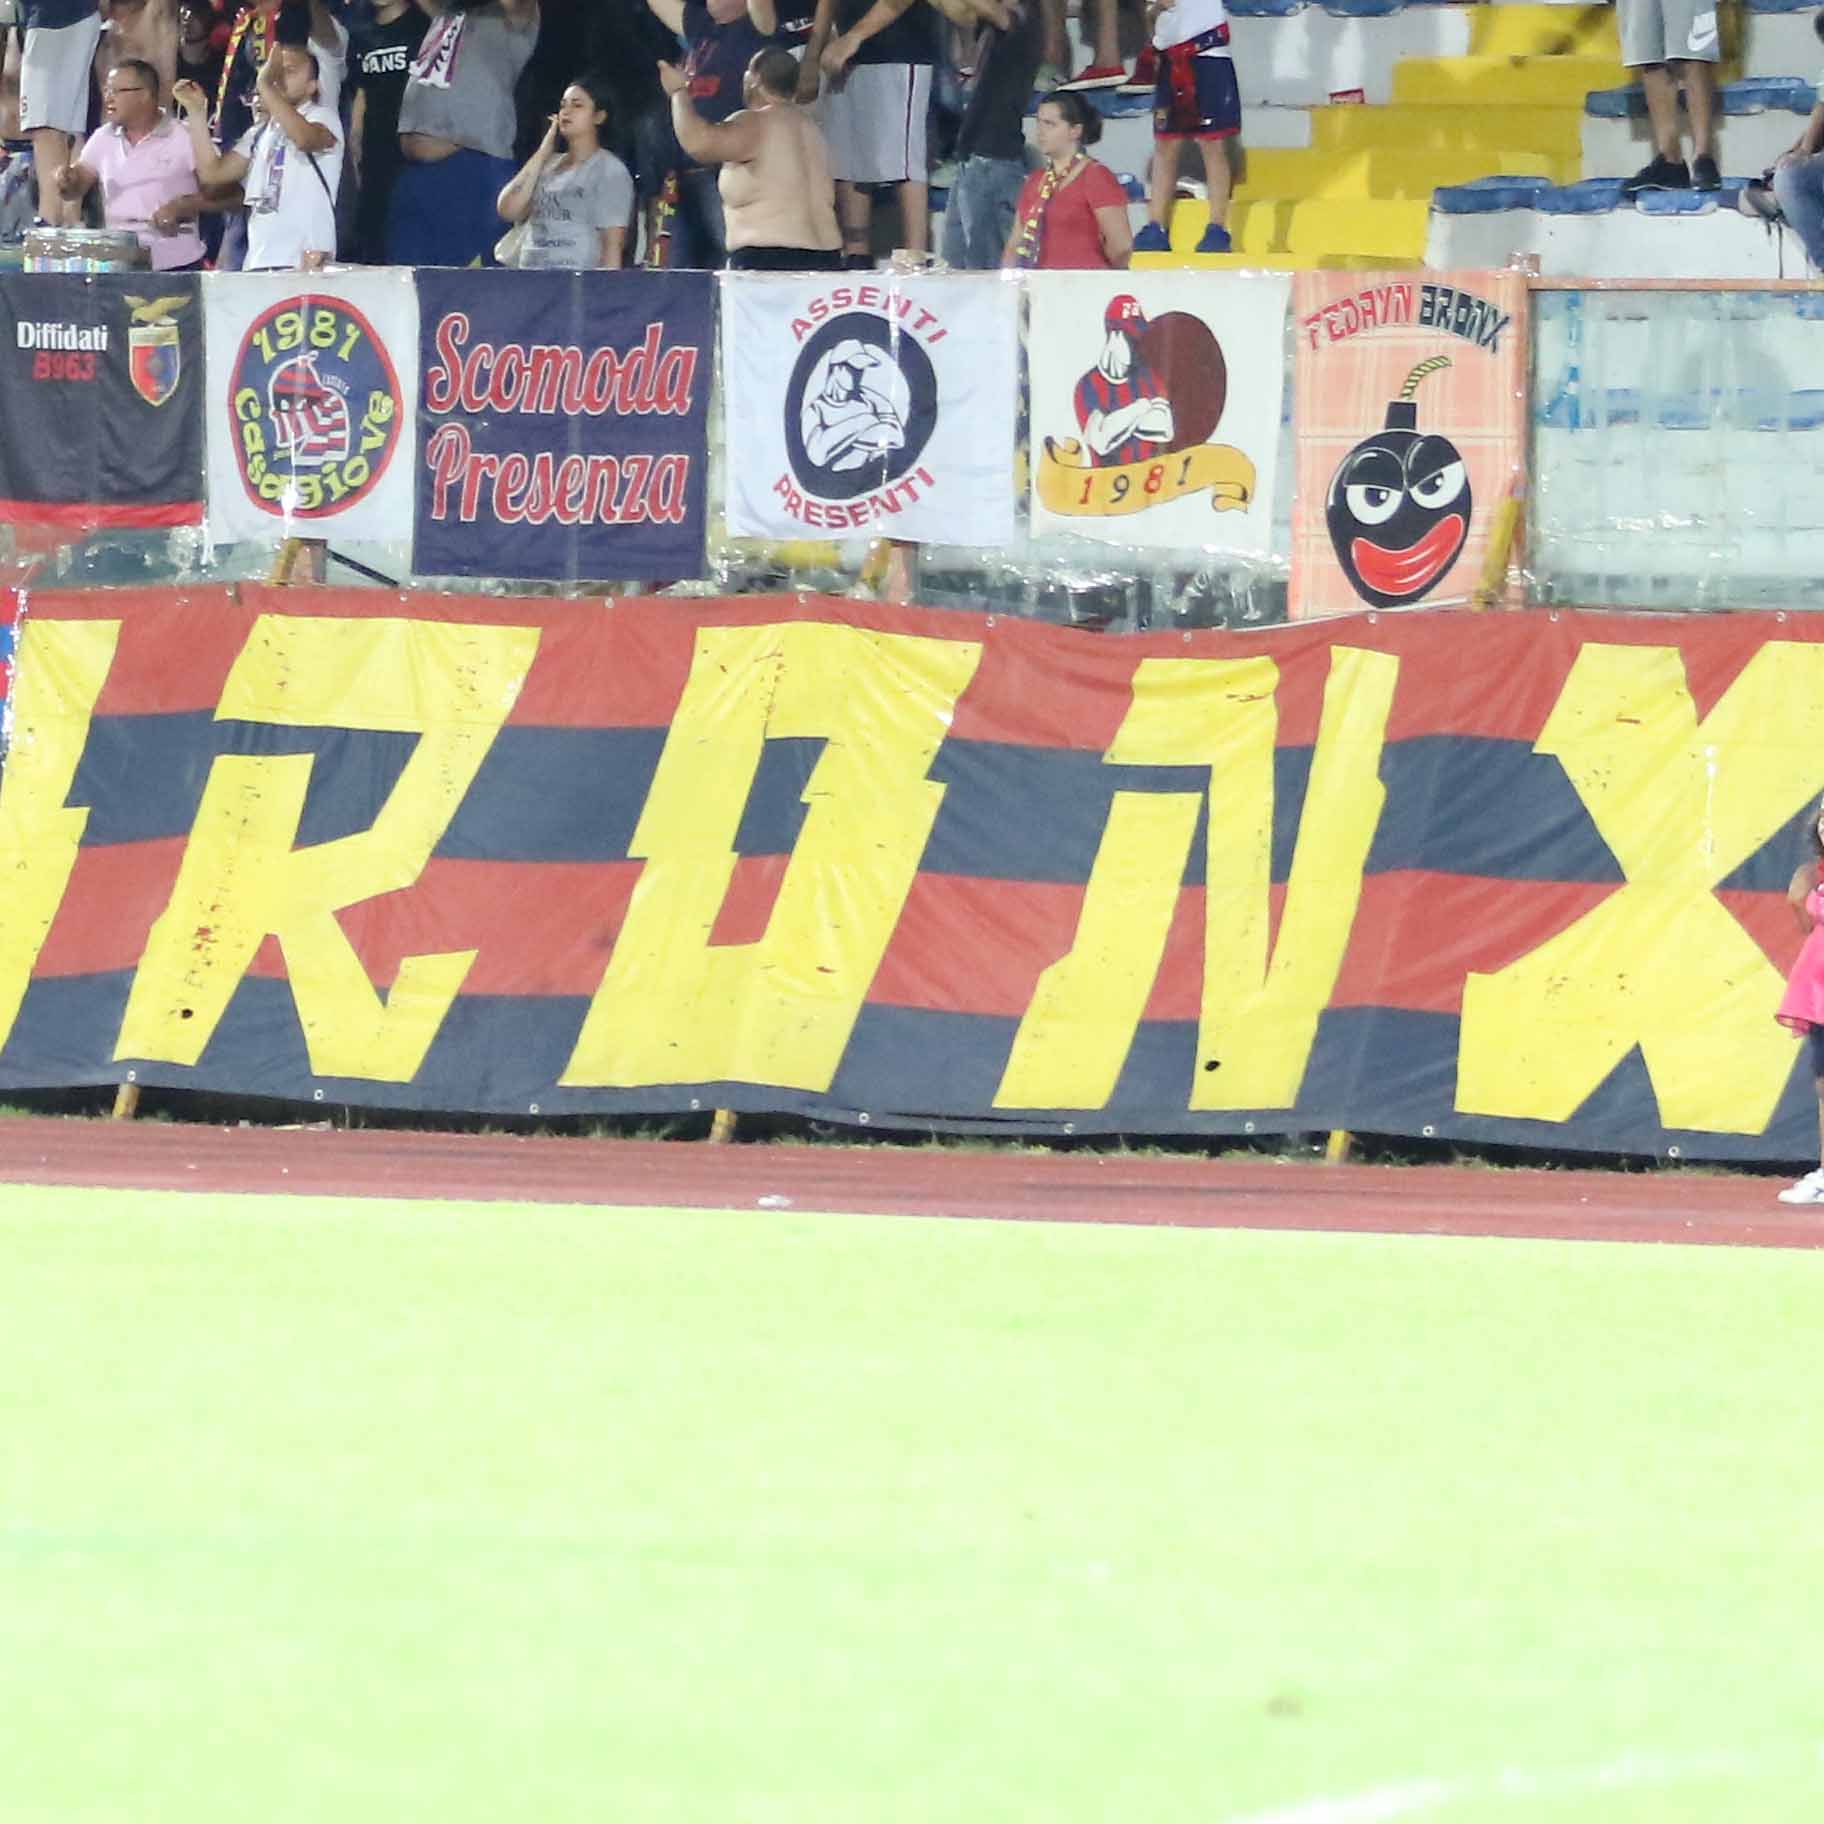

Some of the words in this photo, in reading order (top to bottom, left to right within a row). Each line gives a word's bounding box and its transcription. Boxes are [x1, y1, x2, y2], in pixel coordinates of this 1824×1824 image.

[16, 320, 109, 353] Diffidati
[252, 309, 361, 365] 1981
[789, 286, 948, 344] ASSENTI
[1304, 284, 1412, 350] FEDAYN
[1419, 284, 1510, 354] BRONX
[427, 312, 693, 415] Scomoda
[427, 421, 689, 525] Presenza
[772, 467, 936, 529] PRESENTI
[1080, 455, 1193, 505] 1981
